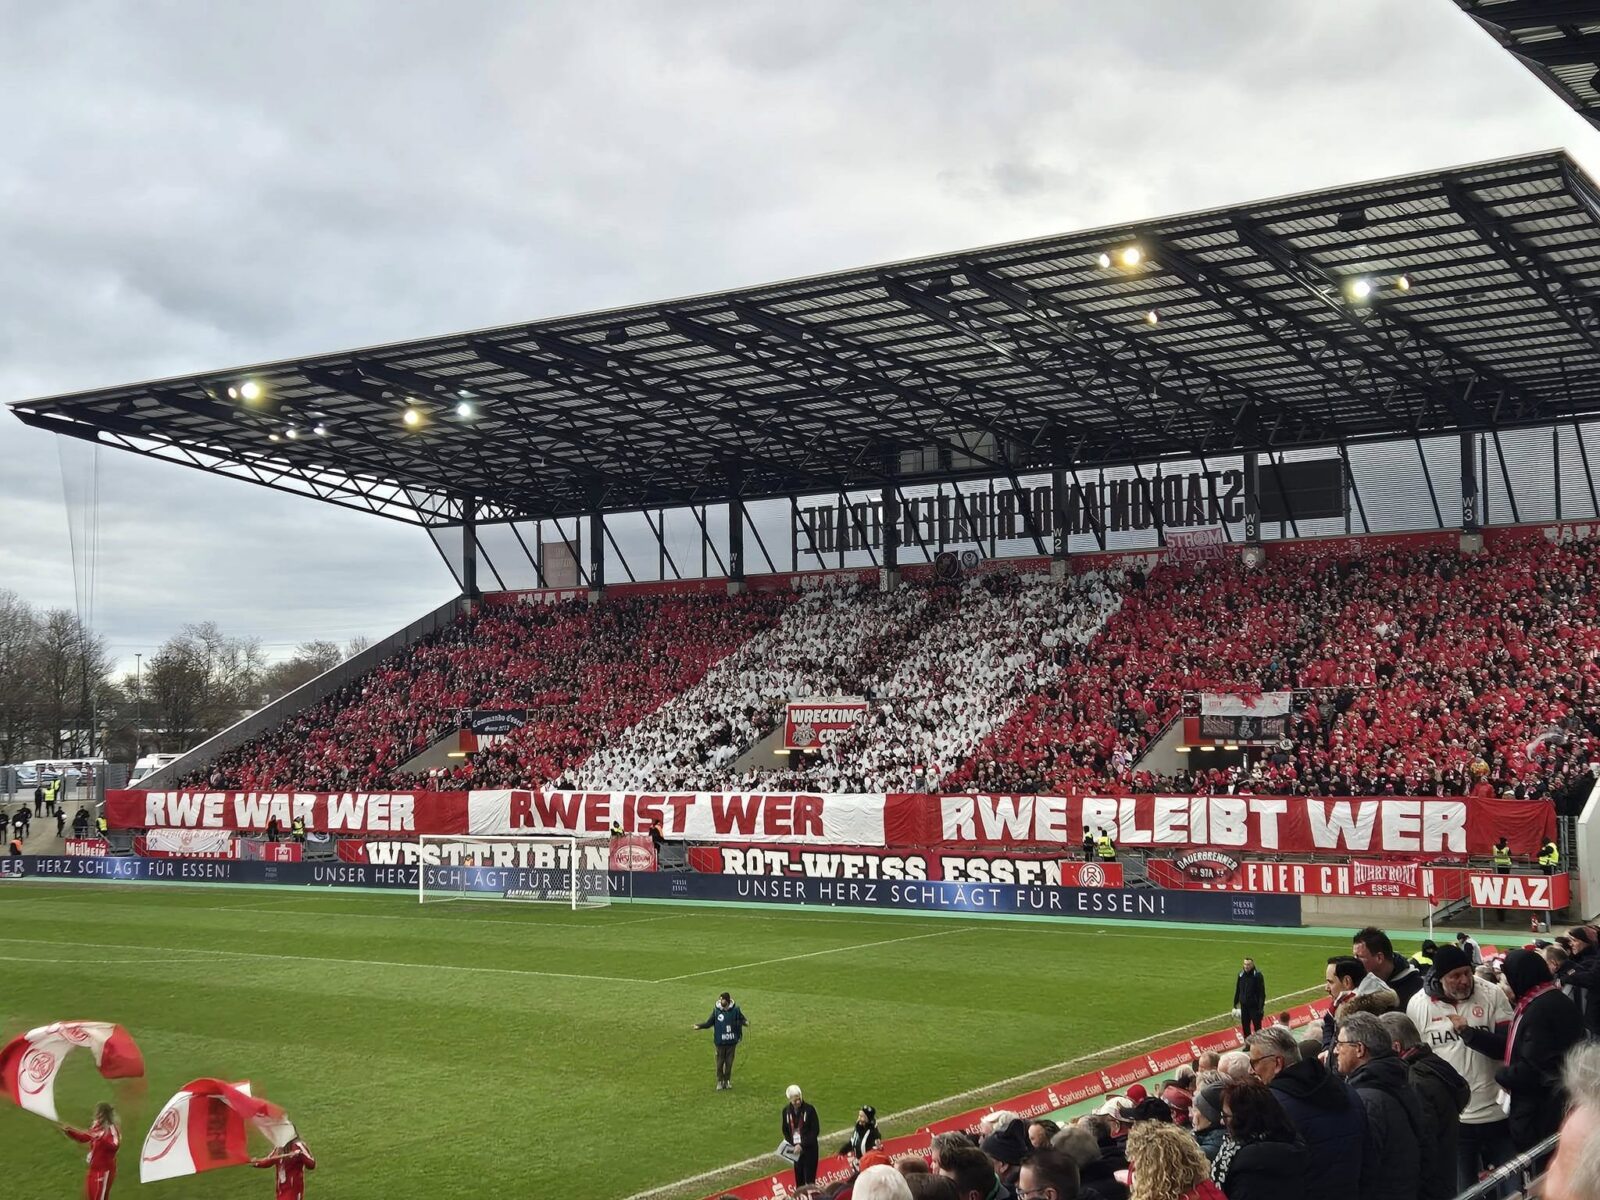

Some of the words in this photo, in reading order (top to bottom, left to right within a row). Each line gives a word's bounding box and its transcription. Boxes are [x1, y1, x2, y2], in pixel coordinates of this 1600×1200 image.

[1463, 497, 1474, 507] W
[1245, 513, 1256, 523] W
[1464, 509, 1473, 521] 3
[1053, 527, 1063, 537] W
[1247, 525, 1255, 536] 3
[1054, 538, 1062, 550] 2
[1168, 546, 1225, 562] KASTEN
[790, 708, 864, 724] WRECKING
[144, 792, 226, 827] RWE
[234, 793, 317, 829] WAR
[327, 793, 415, 831] WER
[510, 791, 611, 832] RWE
[623, 794, 696, 833] IST
[711, 795, 825, 837] WER
[940, 796, 1067, 842] RWE
[1082, 797, 1287, 849] BLEIBT
[1307, 798, 1467, 853] WER
[36, 859, 72, 873] HERZ
[148, 860, 174, 876] FÜR
[182, 863, 231, 878] ESSEN!
[721, 848, 927, 881] ROT-WEISS
[942, 857, 1061, 887] ESSEN
[1177, 851, 1238, 871] DAUERBRENNER
[314, 866, 366, 882] UNSER
[375, 868, 418, 884] HERZ
[428, 869, 508, 887] SCHLÄGT
[519, 870, 552, 889] FÜR
[563, 873, 626, 892] ESSEN!
[1353, 860, 1418, 888] RUHRFRONT
[1371, 884, 1399, 892] ESSEN
[1470, 876, 1549, 907] WAZ
[737, 879, 805, 899] UNSER
[820, 883, 878, 902] HERZ
[891, 884, 1002, 907] SCHLÄGT
[1017, 887, 1062, 910] FÜR
[1078, 891, 1166, 915] ESSEN!
[1233, 901, 1254, 909] MESSE
[1233, 908, 1255, 916] ESSEN
[1156, 1056, 1180, 1071] Sparkasse
[1177, 1052, 1192, 1063] Essen
[1111, 1072, 1136, 1087] Sparkasse
[1133, 1067, 1150, 1079] Essen
[1058, 1089, 1087, 1105] Sparkasse
[1084, 1084, 1102, 1096] Essen
[1030, 1103, 1049, 1116] Essen
[827, 1168, 851, 1182] Essen
